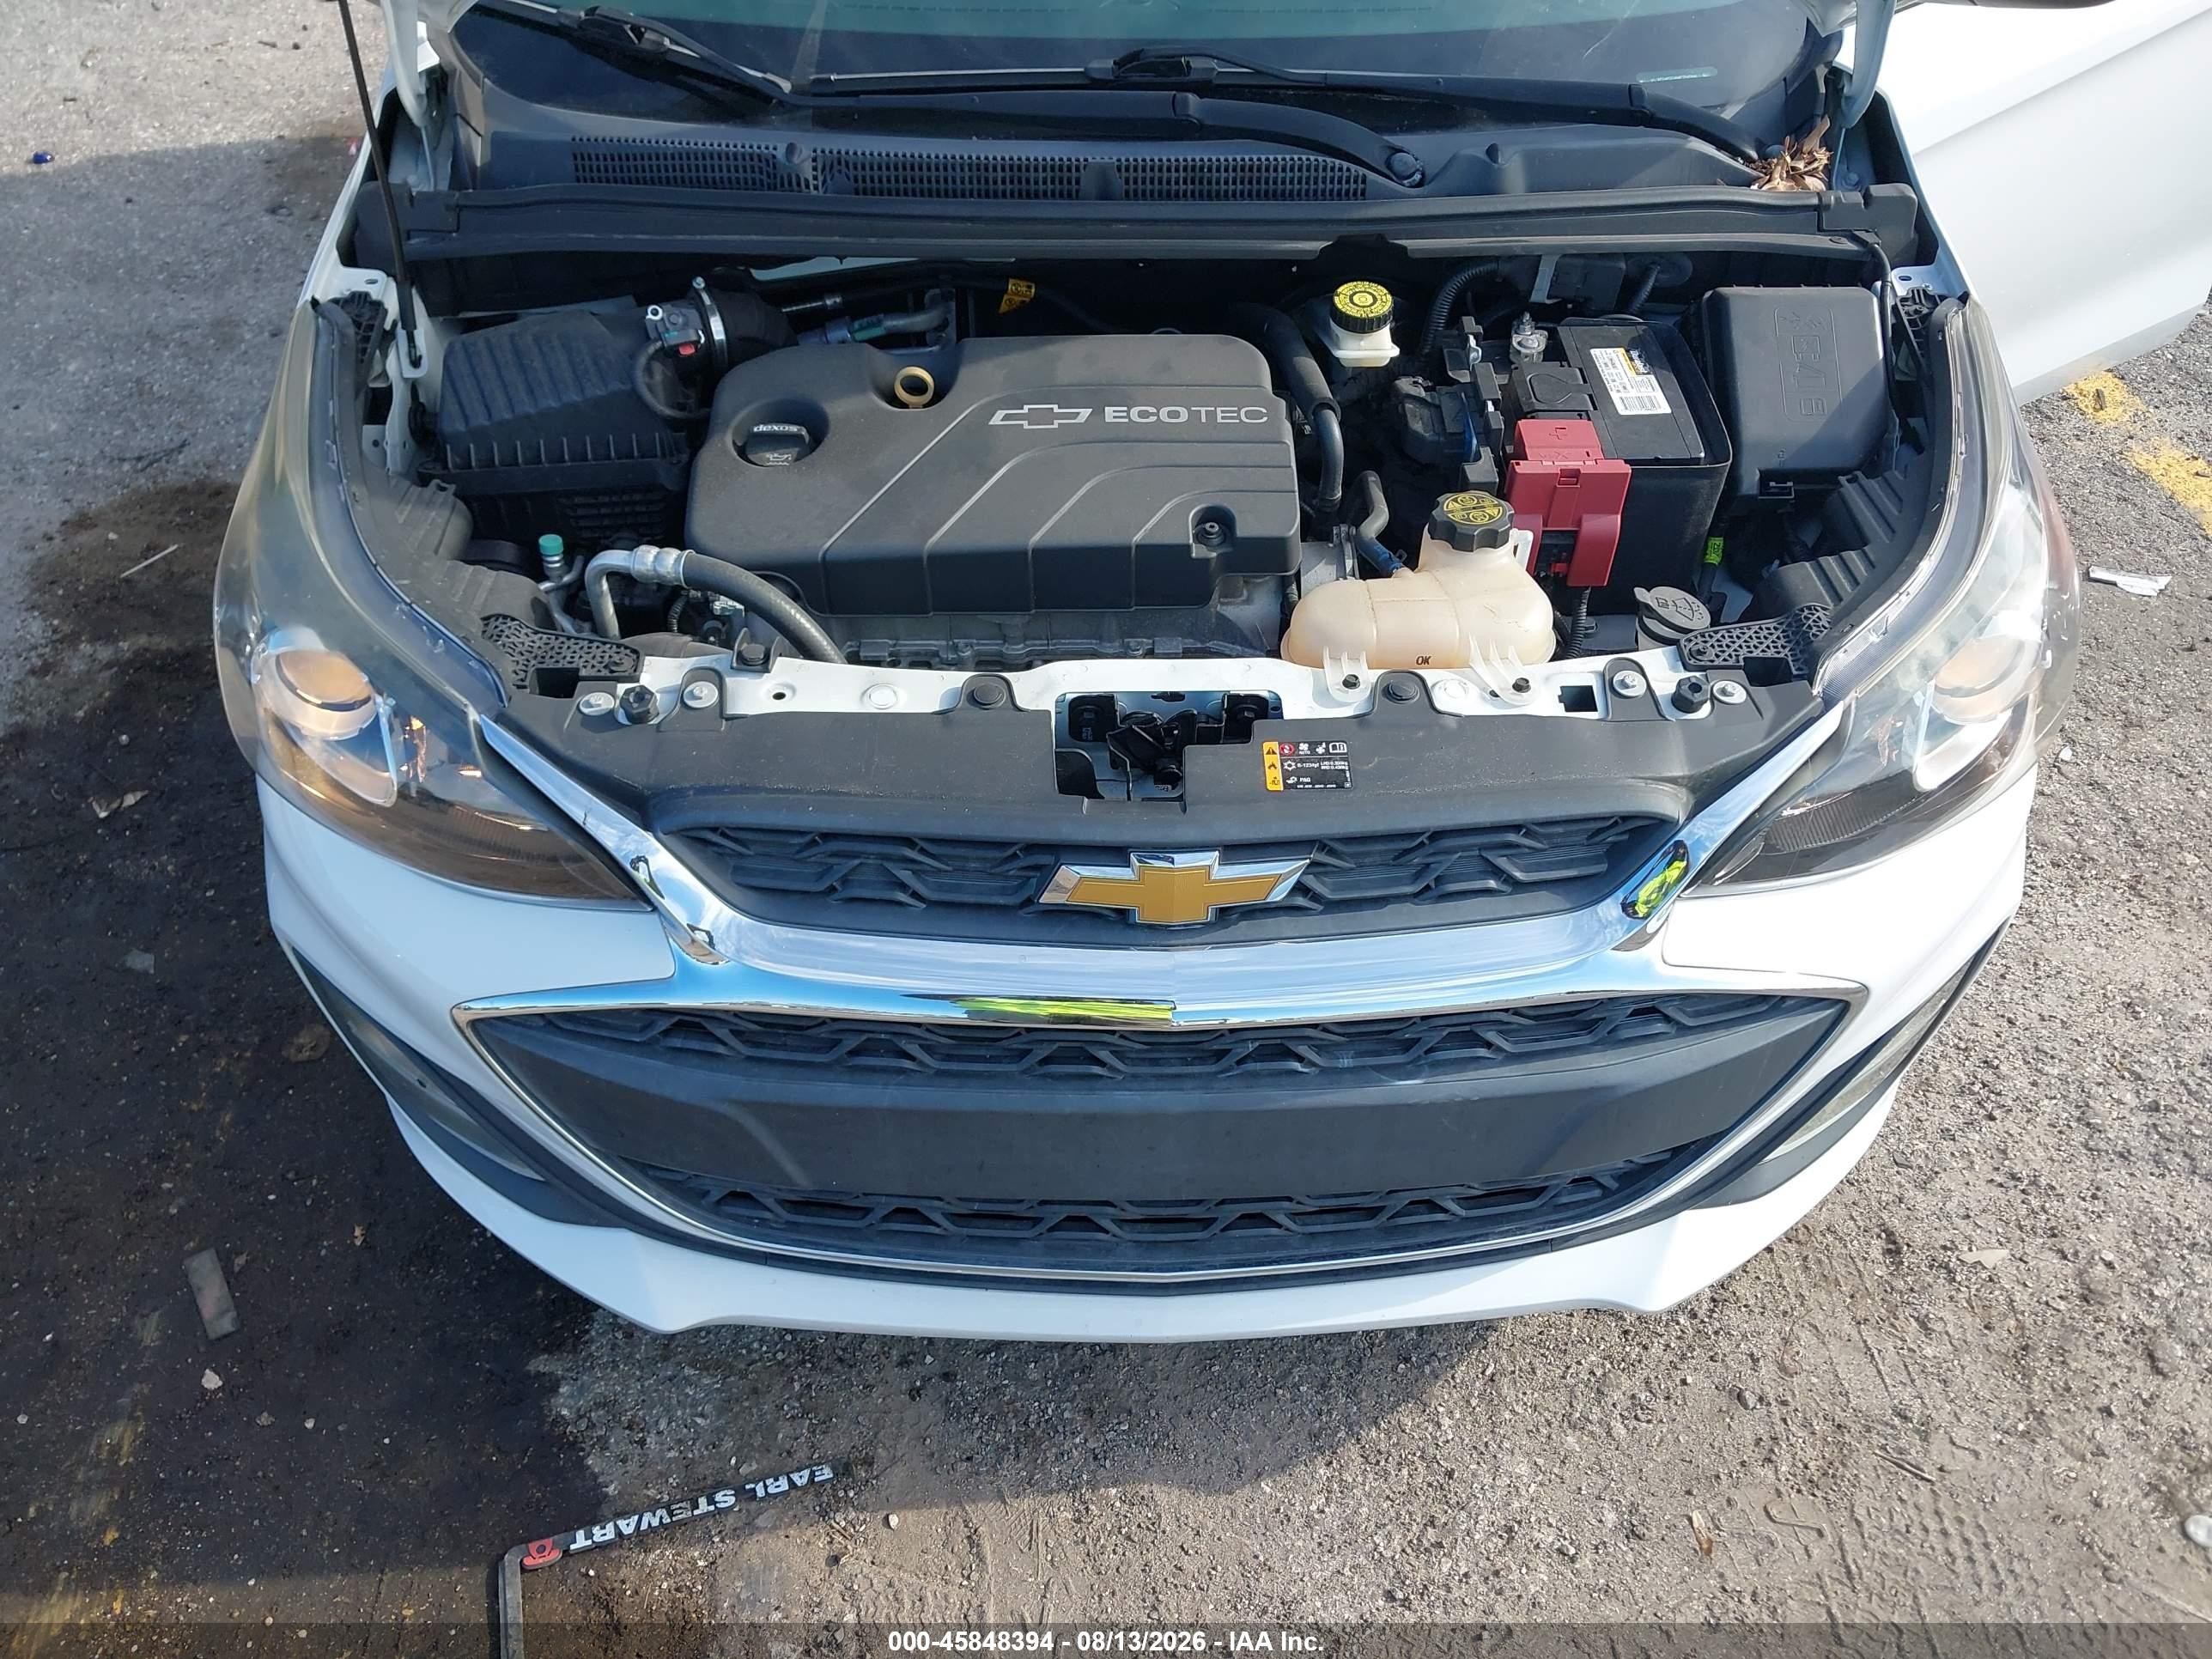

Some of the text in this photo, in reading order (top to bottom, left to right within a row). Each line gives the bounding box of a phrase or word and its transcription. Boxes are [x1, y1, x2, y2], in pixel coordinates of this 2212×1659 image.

[1104, 406, 1268, 423] ECOTEC
[753, 423, 798, 433] dexos
[1415, 655, 1431, 665] OK
[569, 1464, 834, 1550] EARL STEWART
